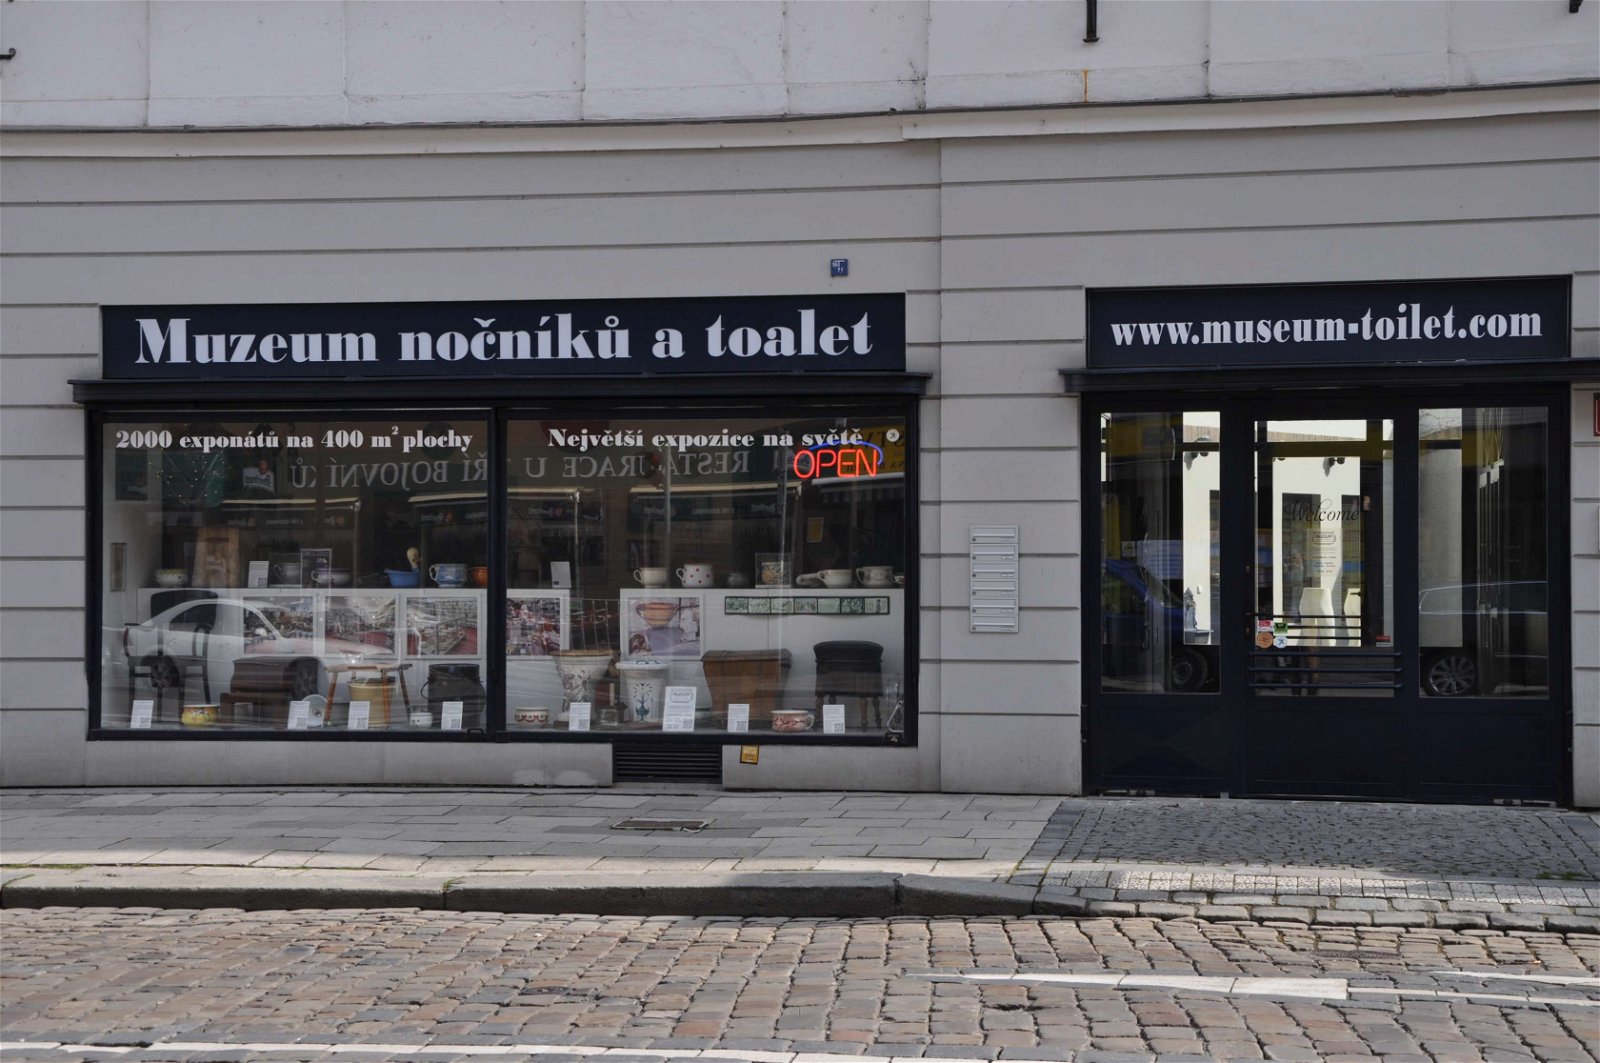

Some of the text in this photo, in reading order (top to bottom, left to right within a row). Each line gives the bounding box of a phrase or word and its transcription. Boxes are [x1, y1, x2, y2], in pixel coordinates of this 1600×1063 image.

[133, 308, 873, 365] Muzeum nočníků a toalet
[1110, 303, 1543, 347] www.museum-toilet.com
[115, 429, 173, 449] 2000
[179, 430, 280, 453] exponátů
[286, 434, 314, 448] na
[320, 429, 364, 449] 400
[402, 429, 473, 453] plochy
[548, 427, 864, 452] Největší expozice na světě
[793, 449, 880, 479] OPEN
[1284, 498, 1360, 522] Welcome
